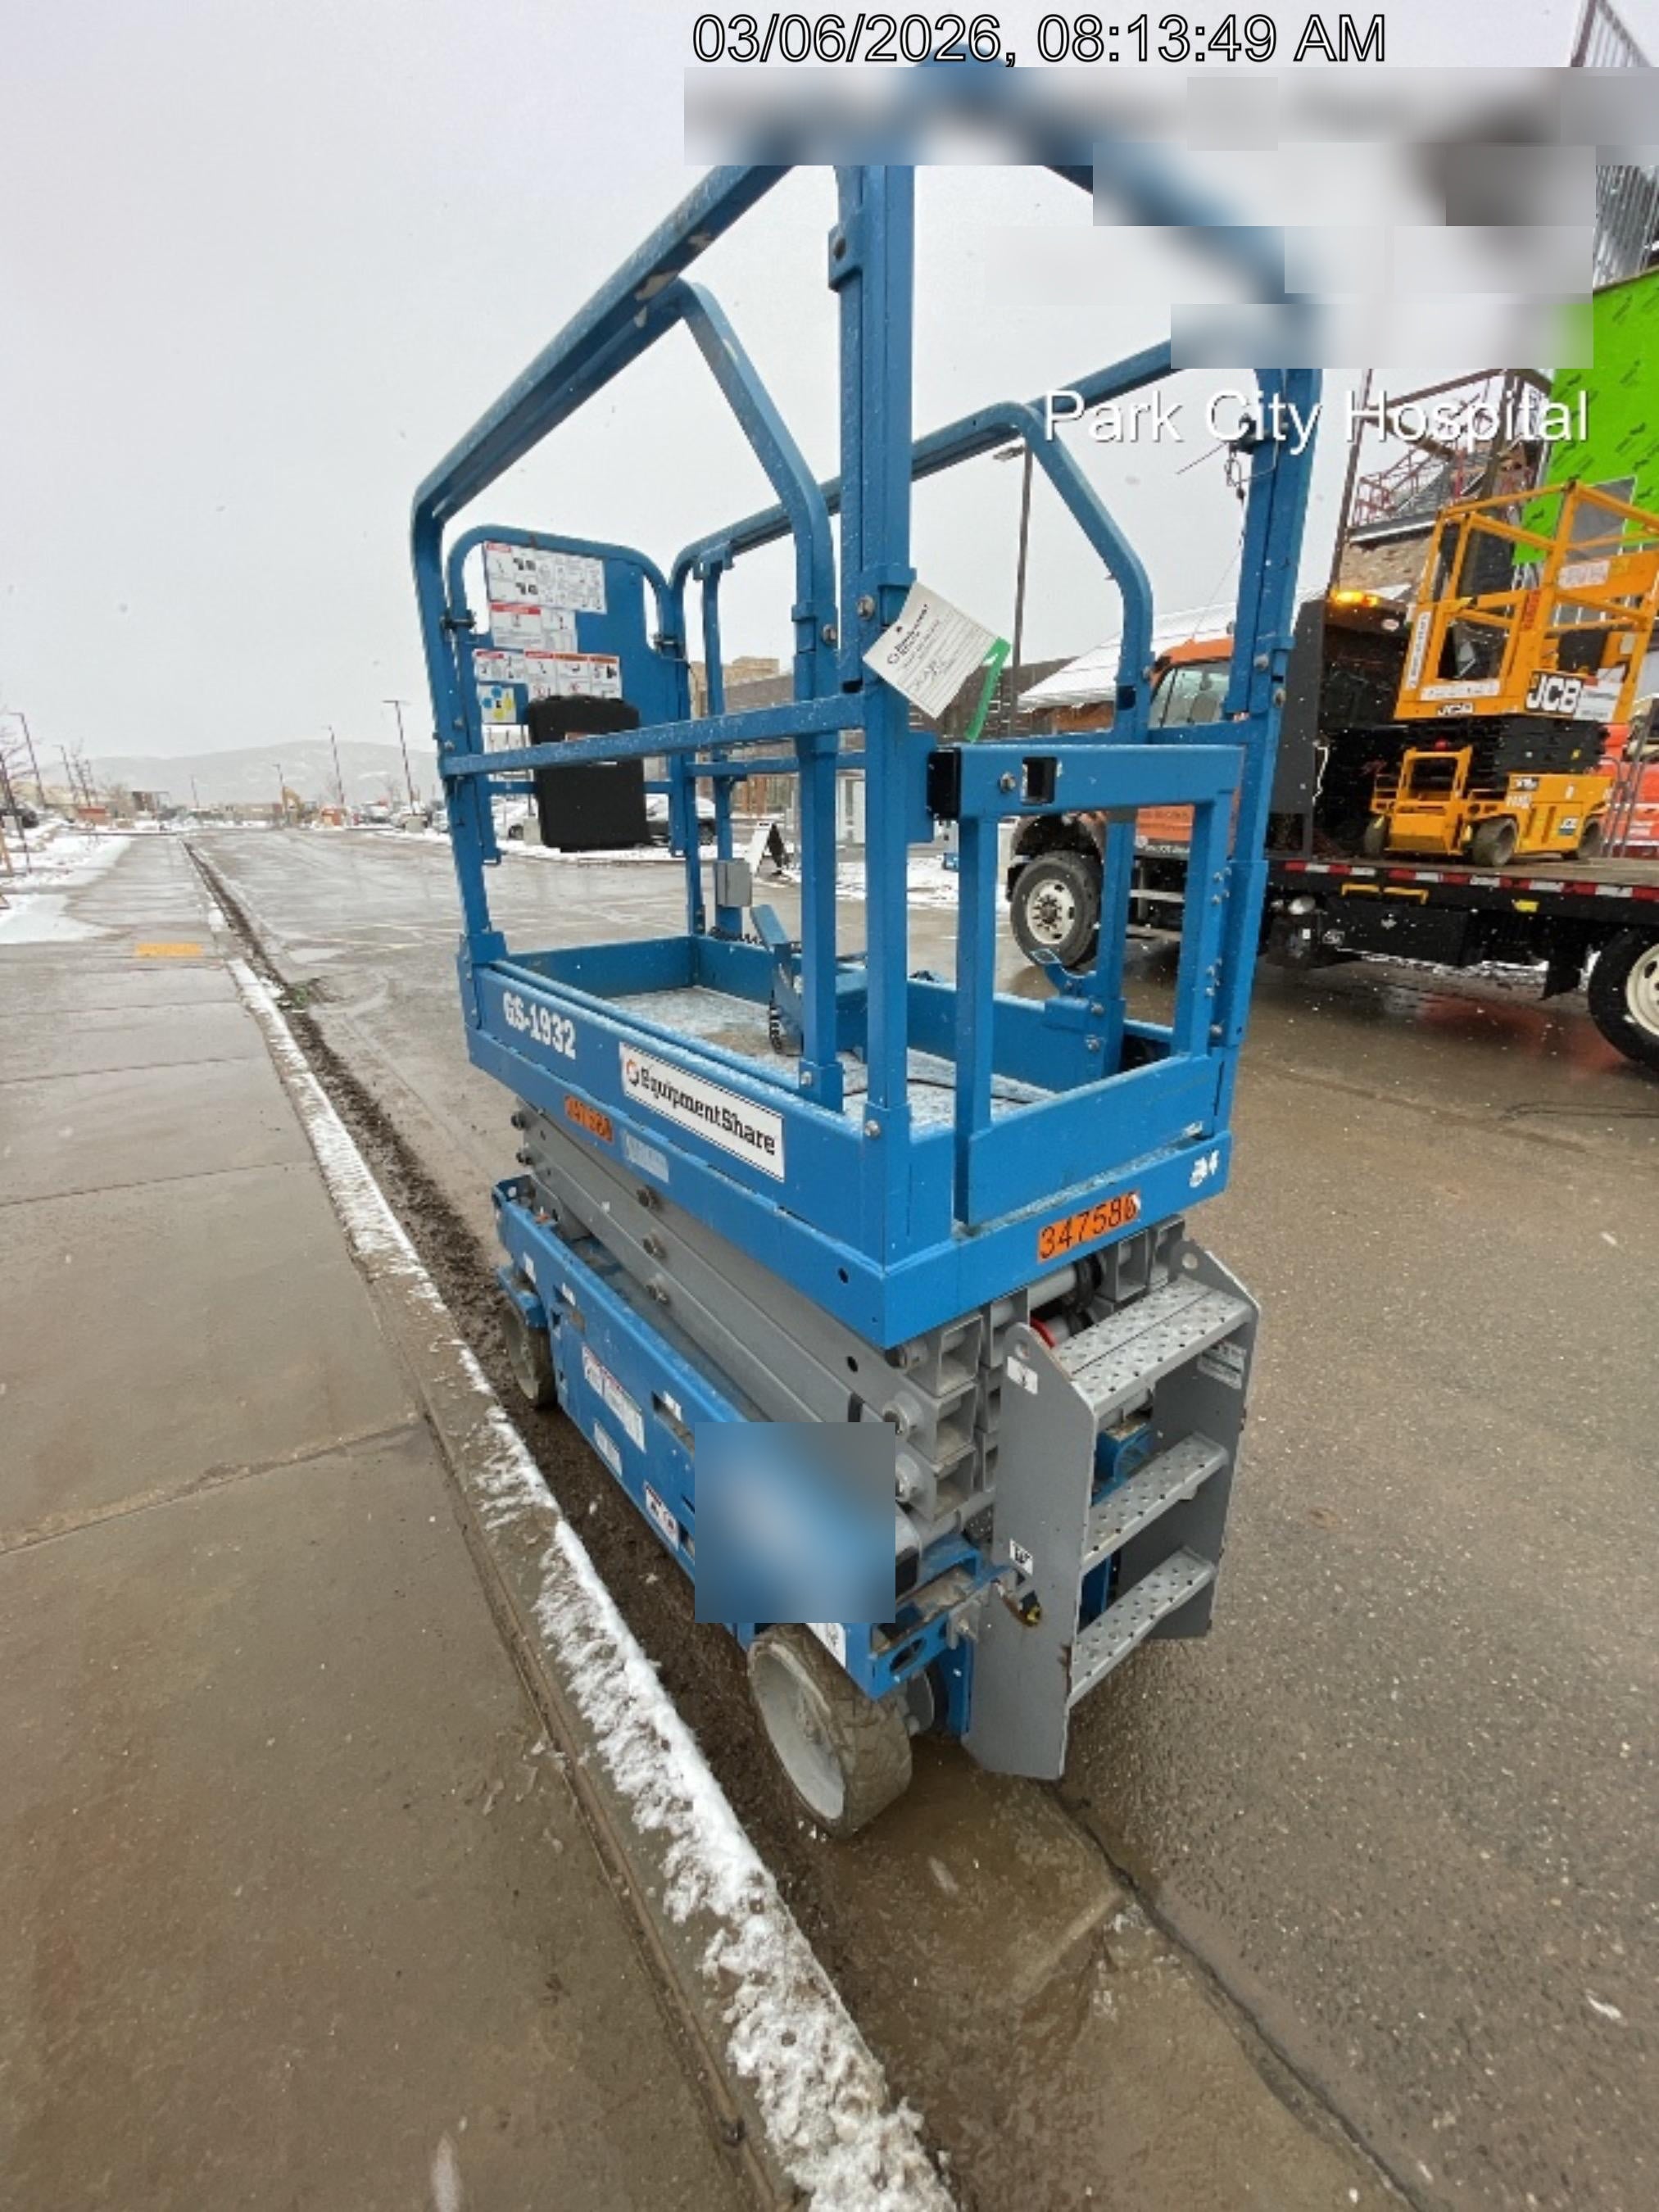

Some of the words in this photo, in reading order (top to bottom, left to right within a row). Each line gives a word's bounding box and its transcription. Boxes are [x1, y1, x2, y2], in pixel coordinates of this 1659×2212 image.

[1526, 674, 1581, 713] JCB
[502, 991, 577, 1061] GS-1932
[640, 1066, 776, 1156] EquipmentShare
